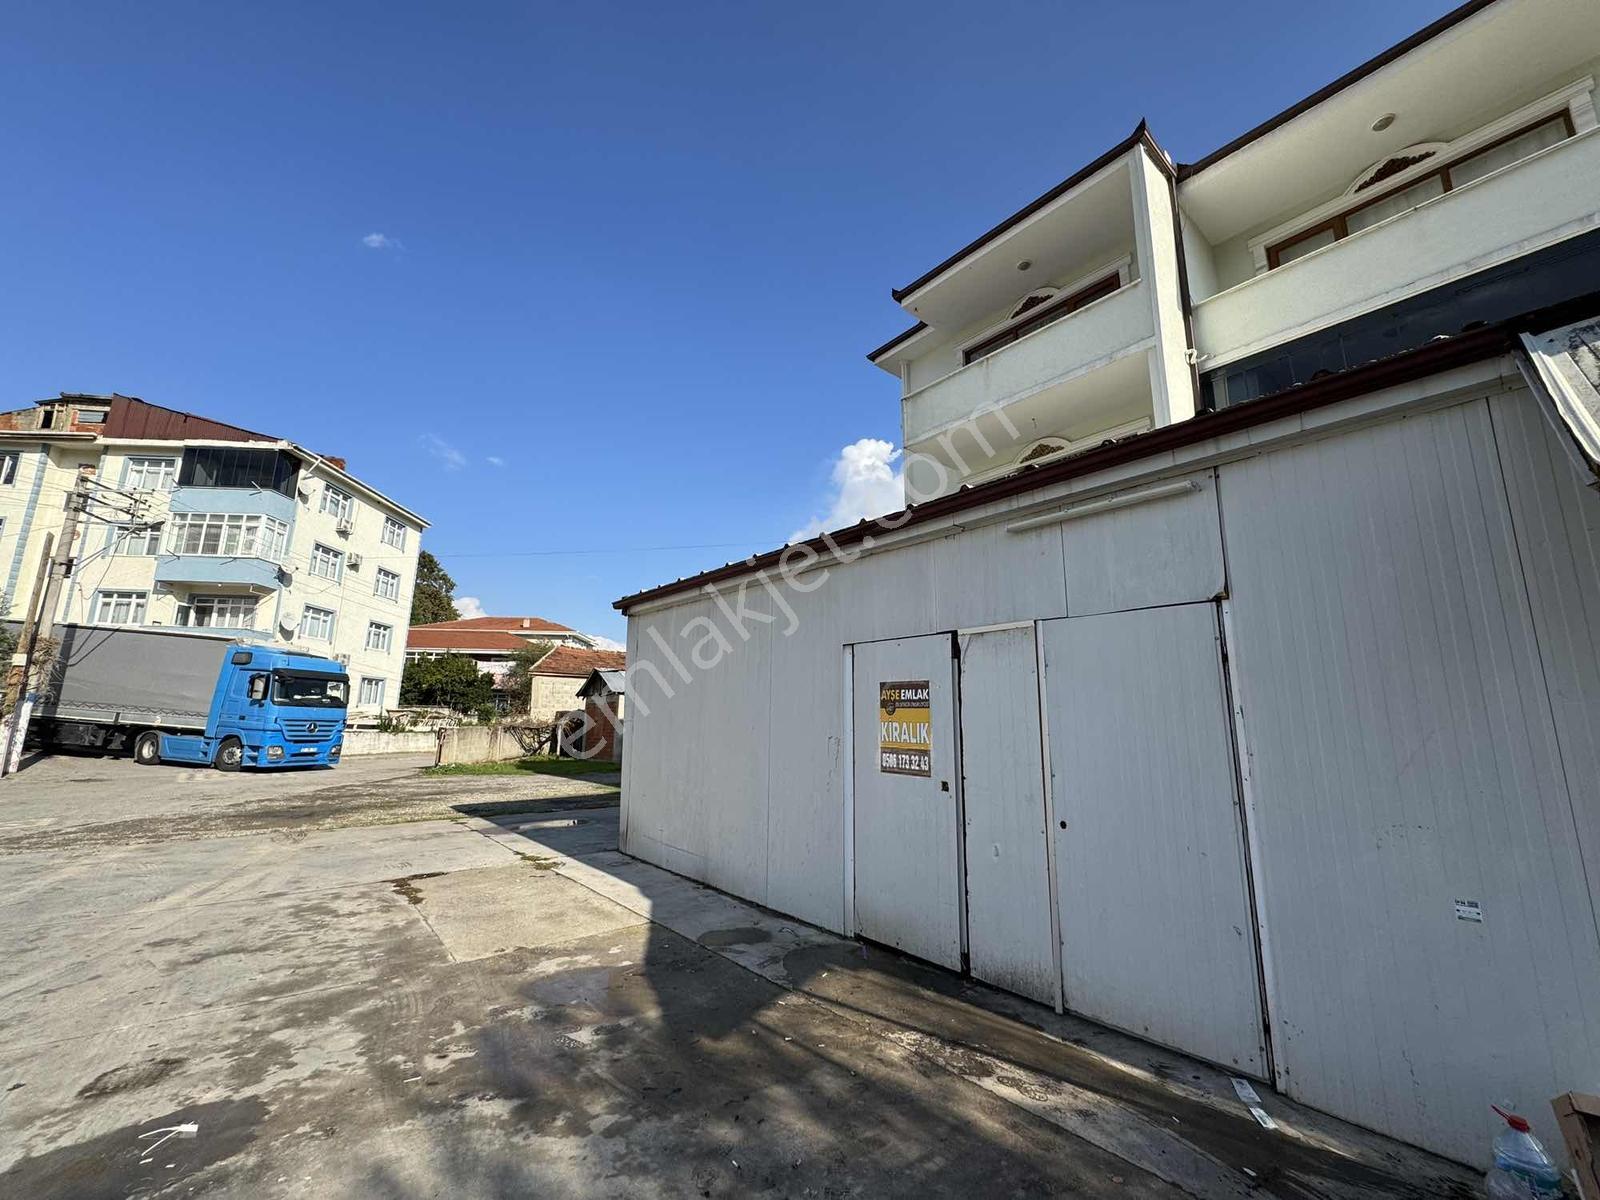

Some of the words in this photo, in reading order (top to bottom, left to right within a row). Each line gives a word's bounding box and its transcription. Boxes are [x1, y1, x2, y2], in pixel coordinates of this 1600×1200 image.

[881, 689, 900, 702] AYŞE
[901, 688, 929, 700] EMLAK
[881, 719, 929, 744] KİRALIK
